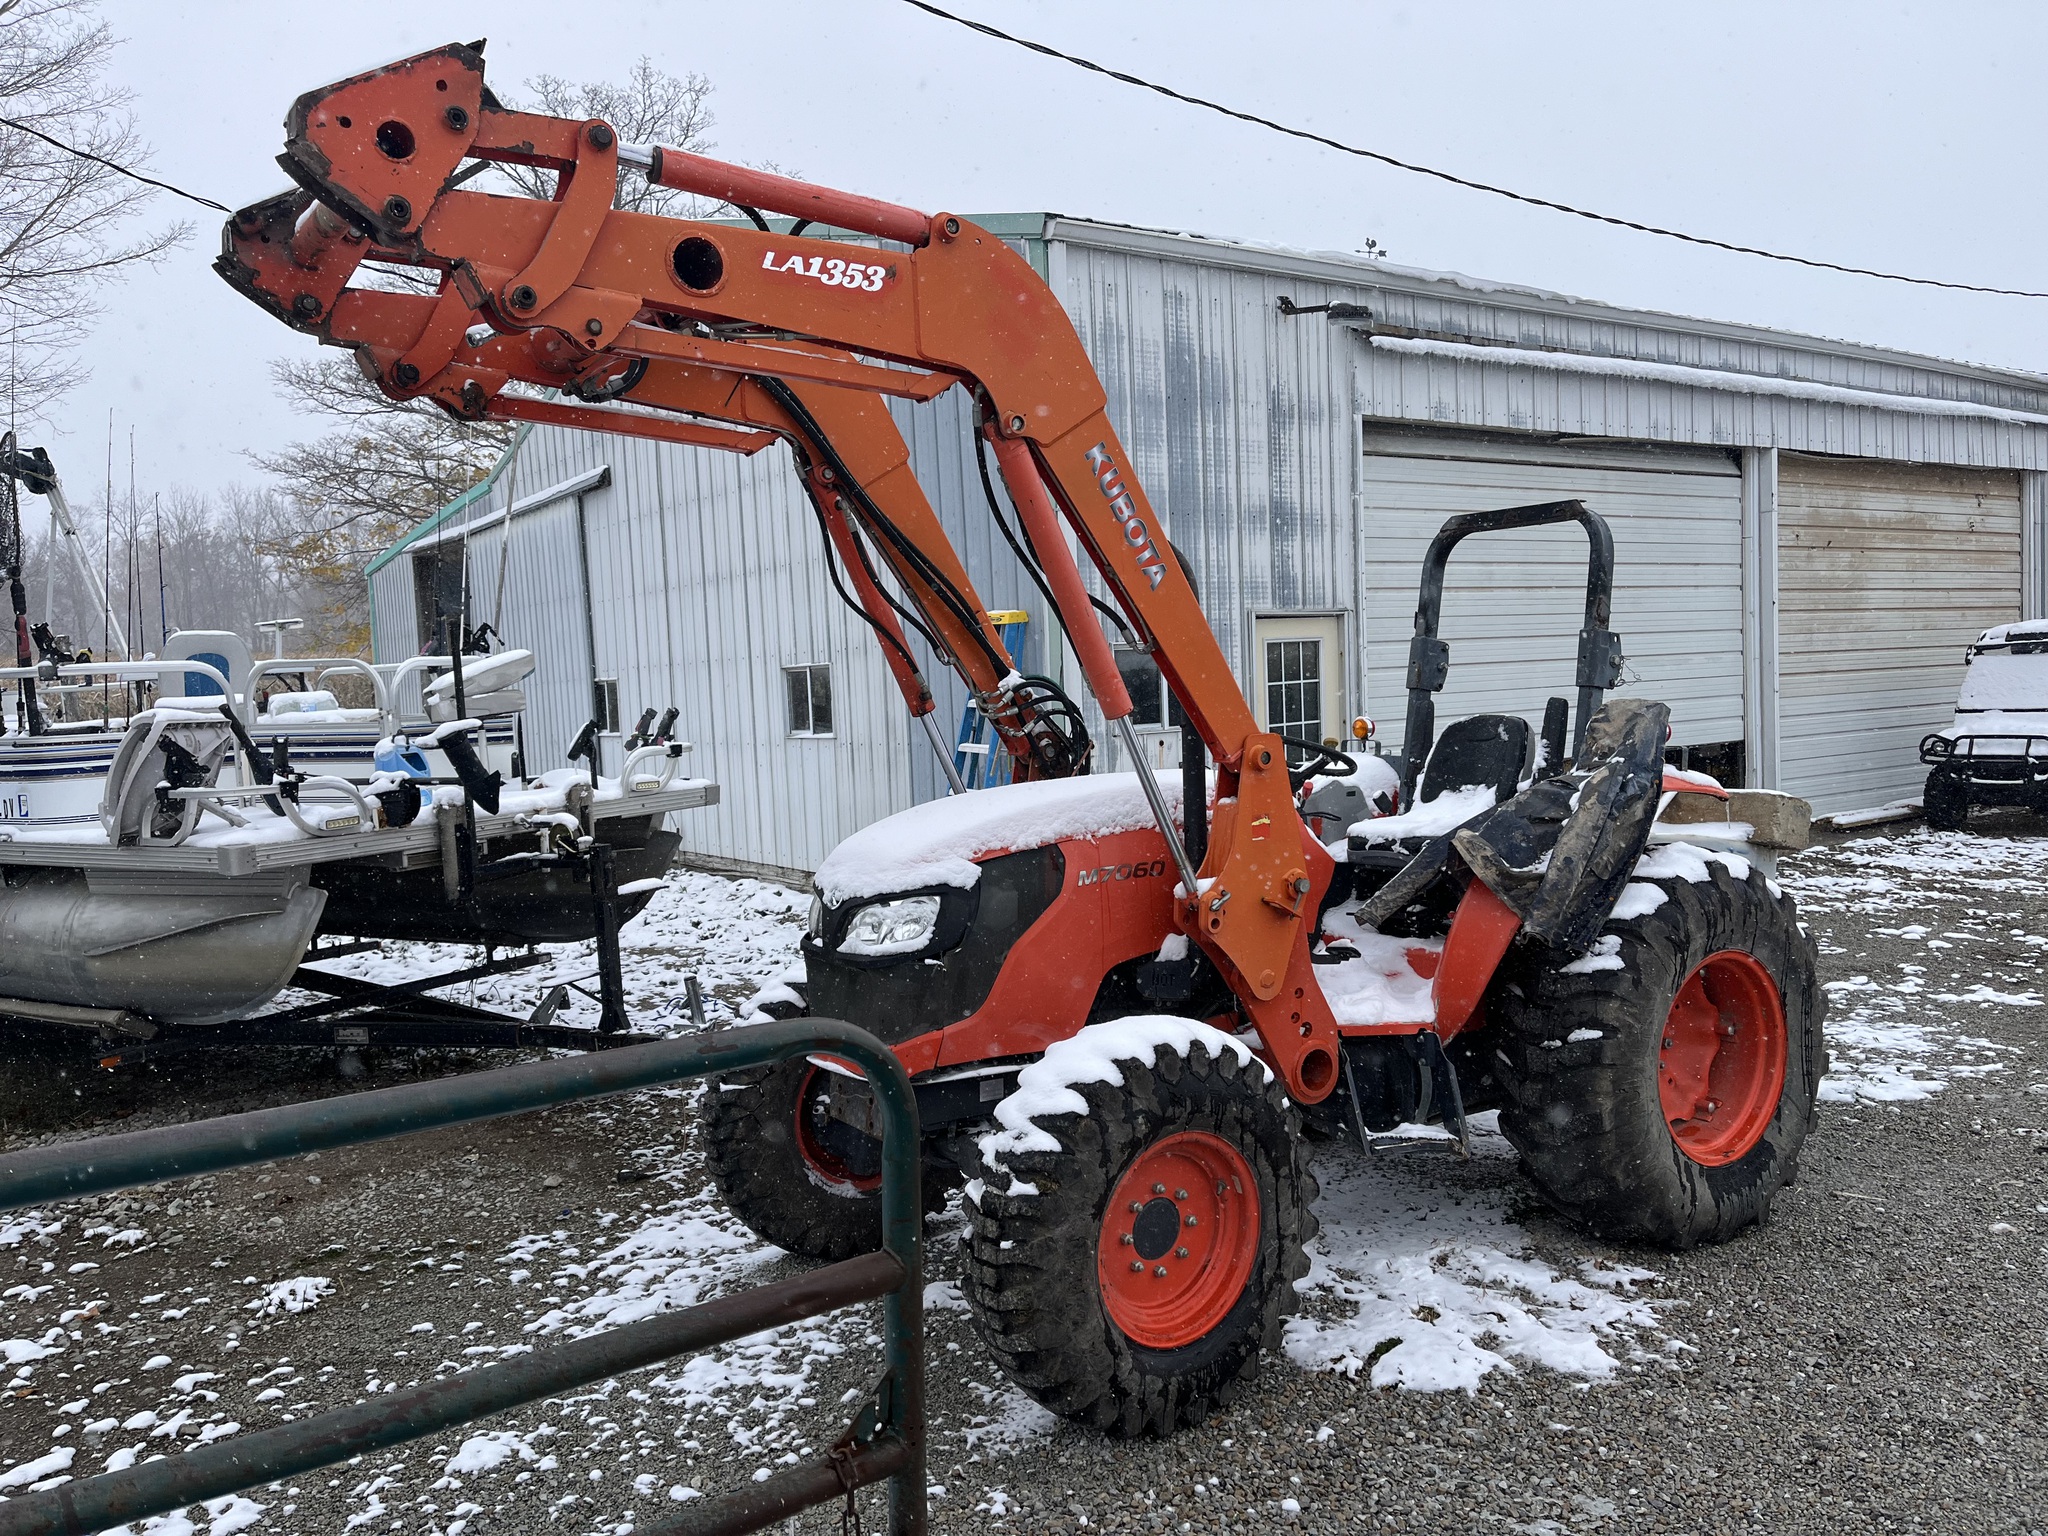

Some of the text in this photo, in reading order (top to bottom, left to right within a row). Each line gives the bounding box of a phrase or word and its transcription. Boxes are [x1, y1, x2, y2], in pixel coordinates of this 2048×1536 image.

[762, 251, 886, 292] LA1353
[1084, 441, 1168, 592] KUBOTA
[1077, 860, 1166, 887] M7060
